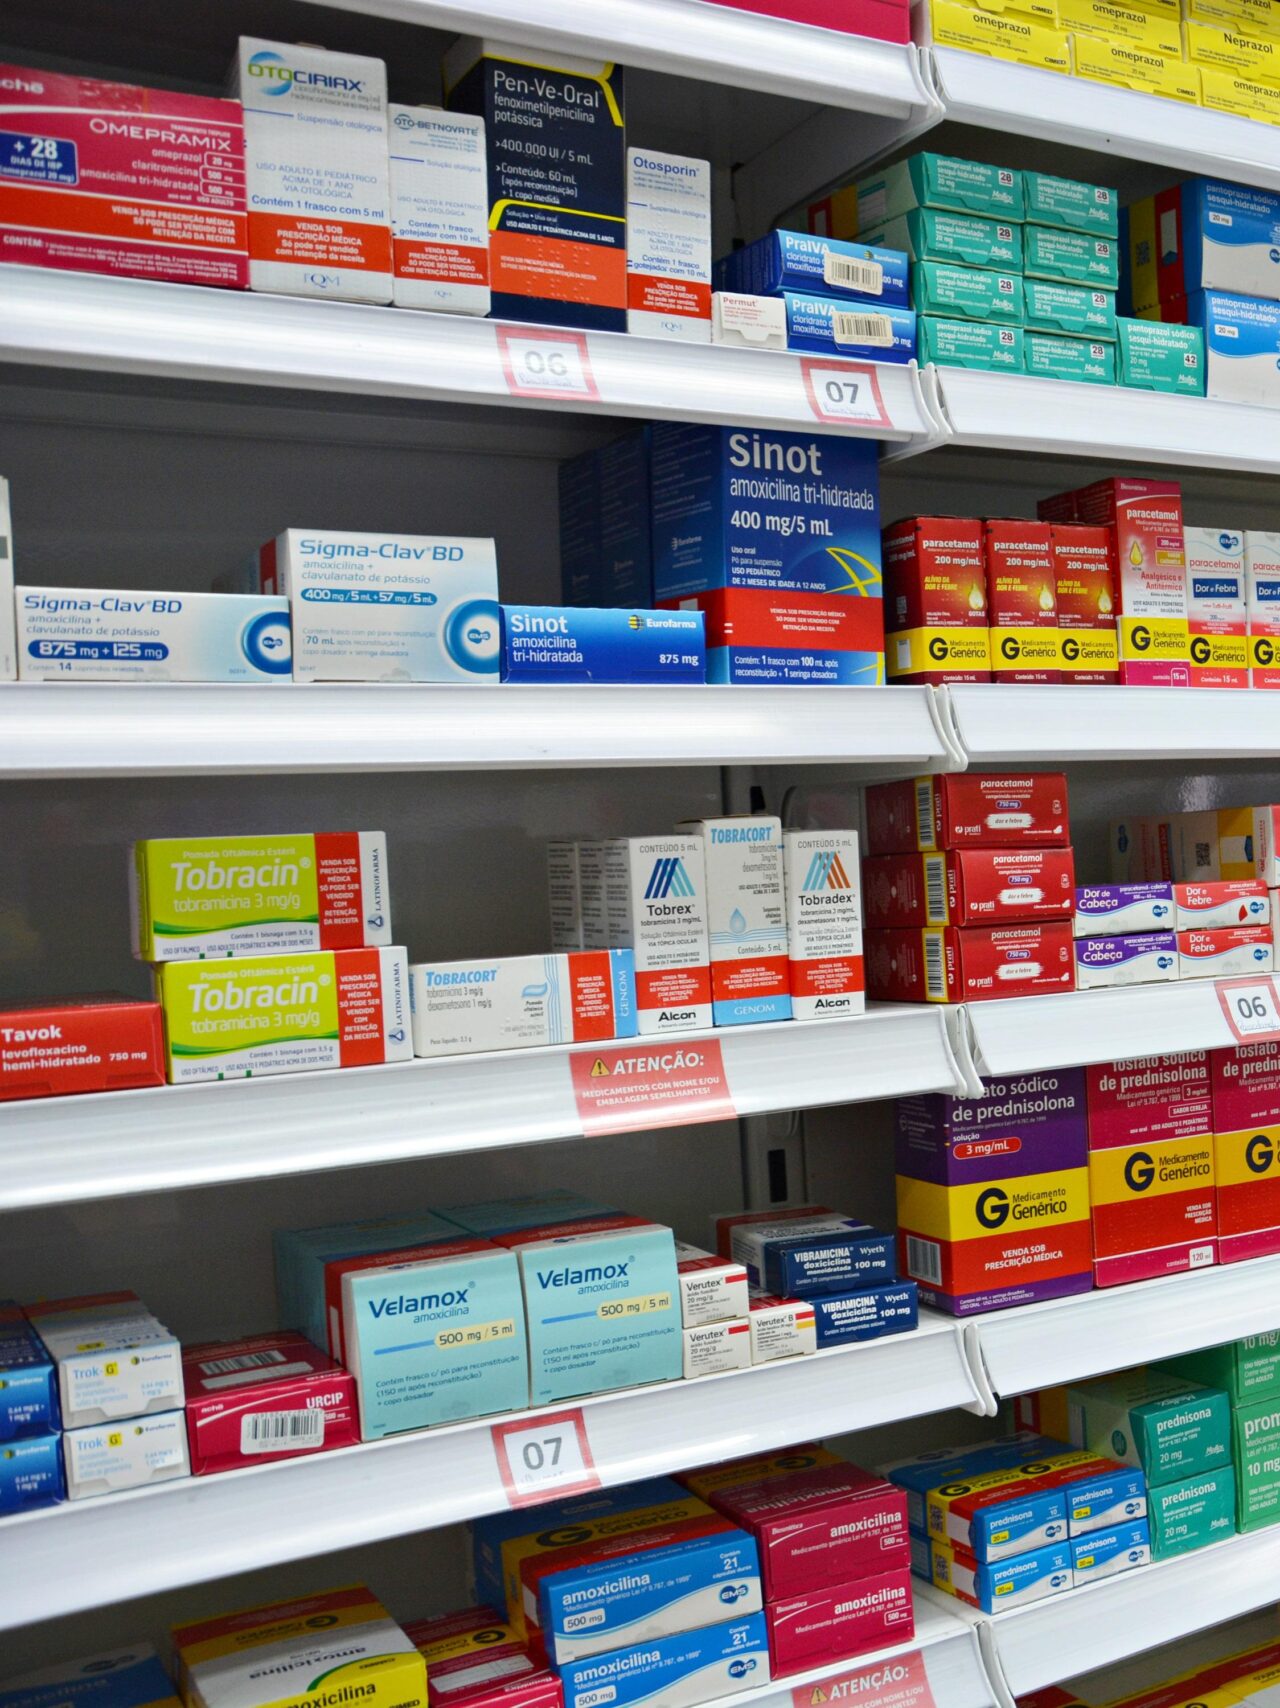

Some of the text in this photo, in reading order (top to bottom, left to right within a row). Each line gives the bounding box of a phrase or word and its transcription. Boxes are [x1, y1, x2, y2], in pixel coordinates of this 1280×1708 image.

[973, 12, 1031, 36] omeprazol
[1224, 33, 1273, 54] Neprazol
[1110, 46, 1164, 68] omeprazol
[494, 70, 599, 108] Pen-Ve-Oral
[494, 94, 595, 123] fenoximetilpenicilina
[494, 110, 543, 128] potássica
[90, 118, 231, 152] OMEPRAMIX
[30, 139, 57, 159] 28
[502, 162, 577, 184] Conteúdo: 60 mL
[634, 156, 697, 178] Otosporin
[524, 352, 568, 376] 06
[825, 381, 859, 404] 07
[729, 434, 822, 476] Sinot
[730, 477, 874, 511] amoxicilina tri-hidratada
[731, 511, 832, 536] 400 mg/5 mL
[1127, 508, 1179, 521] paracetamol
[923, 539, 980, 550] paracetamol
[994, 540, 1049, 552] paracetamol
[934, 556, 980, 567] 200 mg/mL
[1190, 559, 1241, 571] paracetamol
[511, 614, 568, 633] Sinot
[647, 618, 697, 629] Eurofarma
[40, 643, 76, 656] 875
[80, 646, 98, 659] mg
[113, 643, 141, 657] 125
[145, 647, 162, 659] mg
[512, 636, 576, 649] amoxicilina
[1153, 638, 1185, 649] Genérico
[513, 649, 582, 663] tri-hidratada
[659, 654, 699, 666] 875 mg
[950, 647, 986, 659] Genérico
[980, 778, 1033, 790] paracetamol
[711, 827, 771, 844] TOBRACORT
[639, 844, 678, 853] CONTEÚDO
[688, 842, 698, 851] mL
[171, 860, 299, 891] Tobracin
[798, 893, 852, 906] Tobradex
[647, 904, 692, 916] Tobrex
[425, 969, 497, 986] TOBRACORT
[188, 978, 318, 1012] Tobracin
[815, 997, 850, 1009] Alcon
[659, 1010, 696, 1021] Alcon
[1237, 996, 1267, 1019] 06
[191, 1014, 270, 1032] tobramicina
[285, 1012, 320, 1029] mg/g
[2, 1025, 61, 1041] Tavok
[2, 1043, 86, 1059] levofloxacino
[109, 1051, 146, 1061] 750 mg
[3, 1054, 100, 1071] hemi-hidratado
[613, 1052, 704, 1075] ATENÇÃO:
[1100, 1066, 1207, 1091] de prednisolona
[953, 1095, 1075, 1122] de prednisolona
[1159, 1162, 1210, 1180] Genérico
[1012, 1200, 1067, 1219] Genérico
[985, 1251, 1063, 1271] PRESCRIÇÃO MÉDICA
[1002, 1245, 1046, 1259] VENDA SOB
[803, 1257, 851, 1270] doxiciclina
[536, 1263, 629, 1289] Velamox
[686, 1278, 721, 1291] Verutex
[369, 1288, 469, 1319] Velamox
[601, 1302, 624, 1316] 500
[626, 1303, 640, 1314] mg
[659, 1297, 669, 1307] ml
[1157, 1408, 1212, 1433] prednisona
[522, 1436, 563, 1470] 07
[1248, 1461, 1261, 1475] 10
[724, 1559, 738, 1571] 21
[562, 1574, 650, 1605] amoxicilina
[830, 1666, 908, 1700] ATENÇÃO:
